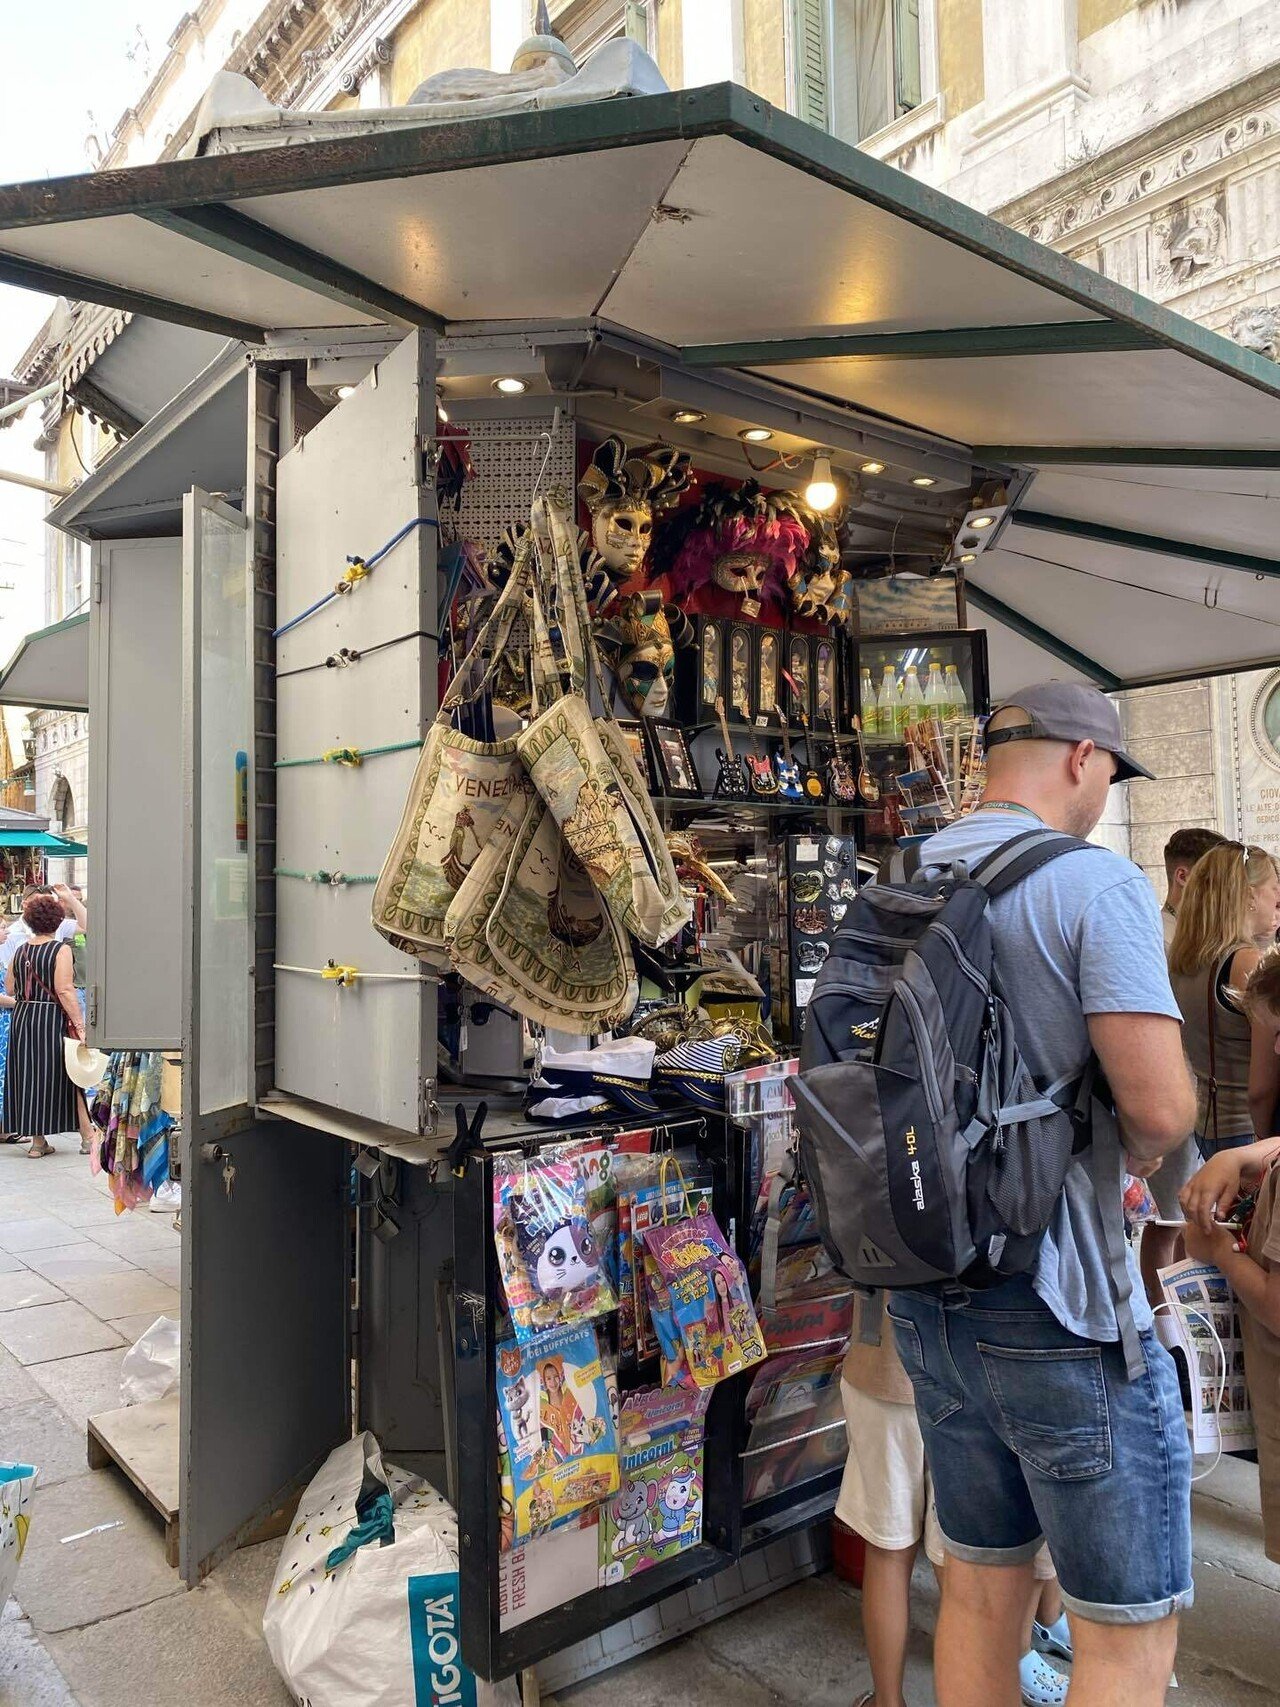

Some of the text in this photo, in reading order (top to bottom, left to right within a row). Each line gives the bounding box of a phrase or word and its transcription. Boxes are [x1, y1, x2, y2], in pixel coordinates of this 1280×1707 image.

[906, 1125, 925, 1211] alaska 40L
[543, 1329, 590, 1354] BUFFYCATS
[513, 1566, 526, 1611] FRESH
